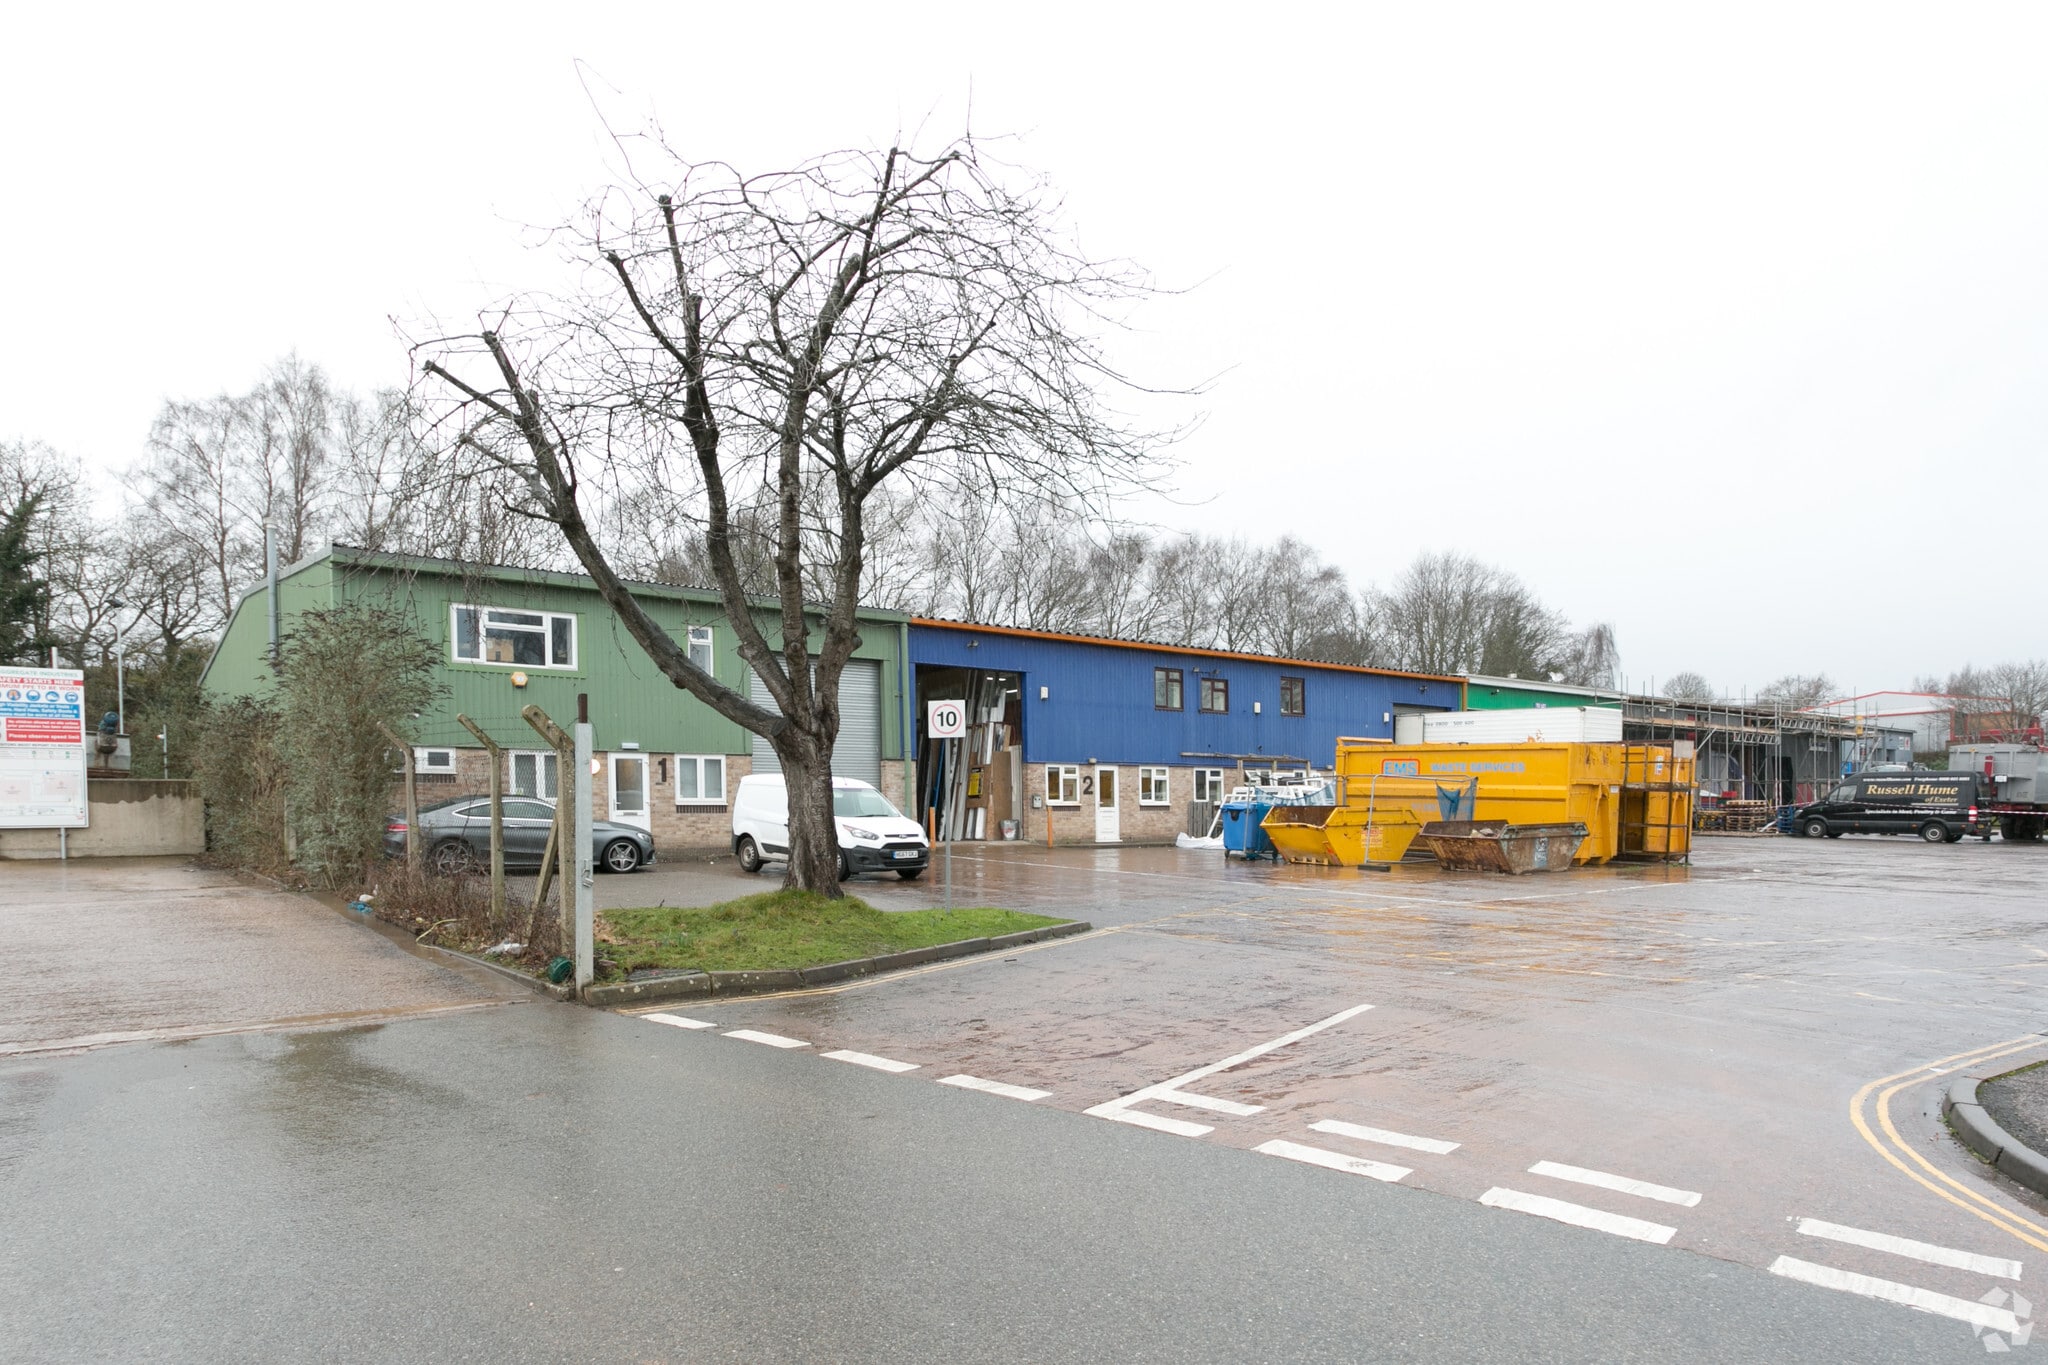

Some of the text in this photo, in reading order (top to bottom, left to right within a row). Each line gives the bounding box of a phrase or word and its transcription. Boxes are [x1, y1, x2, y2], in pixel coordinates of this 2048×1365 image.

[23, 677, 52, 685] STARTS
[937, 711, 957, 727] 10
[658, 757, 667, 783] 1
[1384, 762, 1525, 776] EMS WASTE SERVICES
[1083, 775, 1094, 795] 2
[1866, 784, 1959, 795] Russell Hume
[1924, 796, 1934, 804] of
